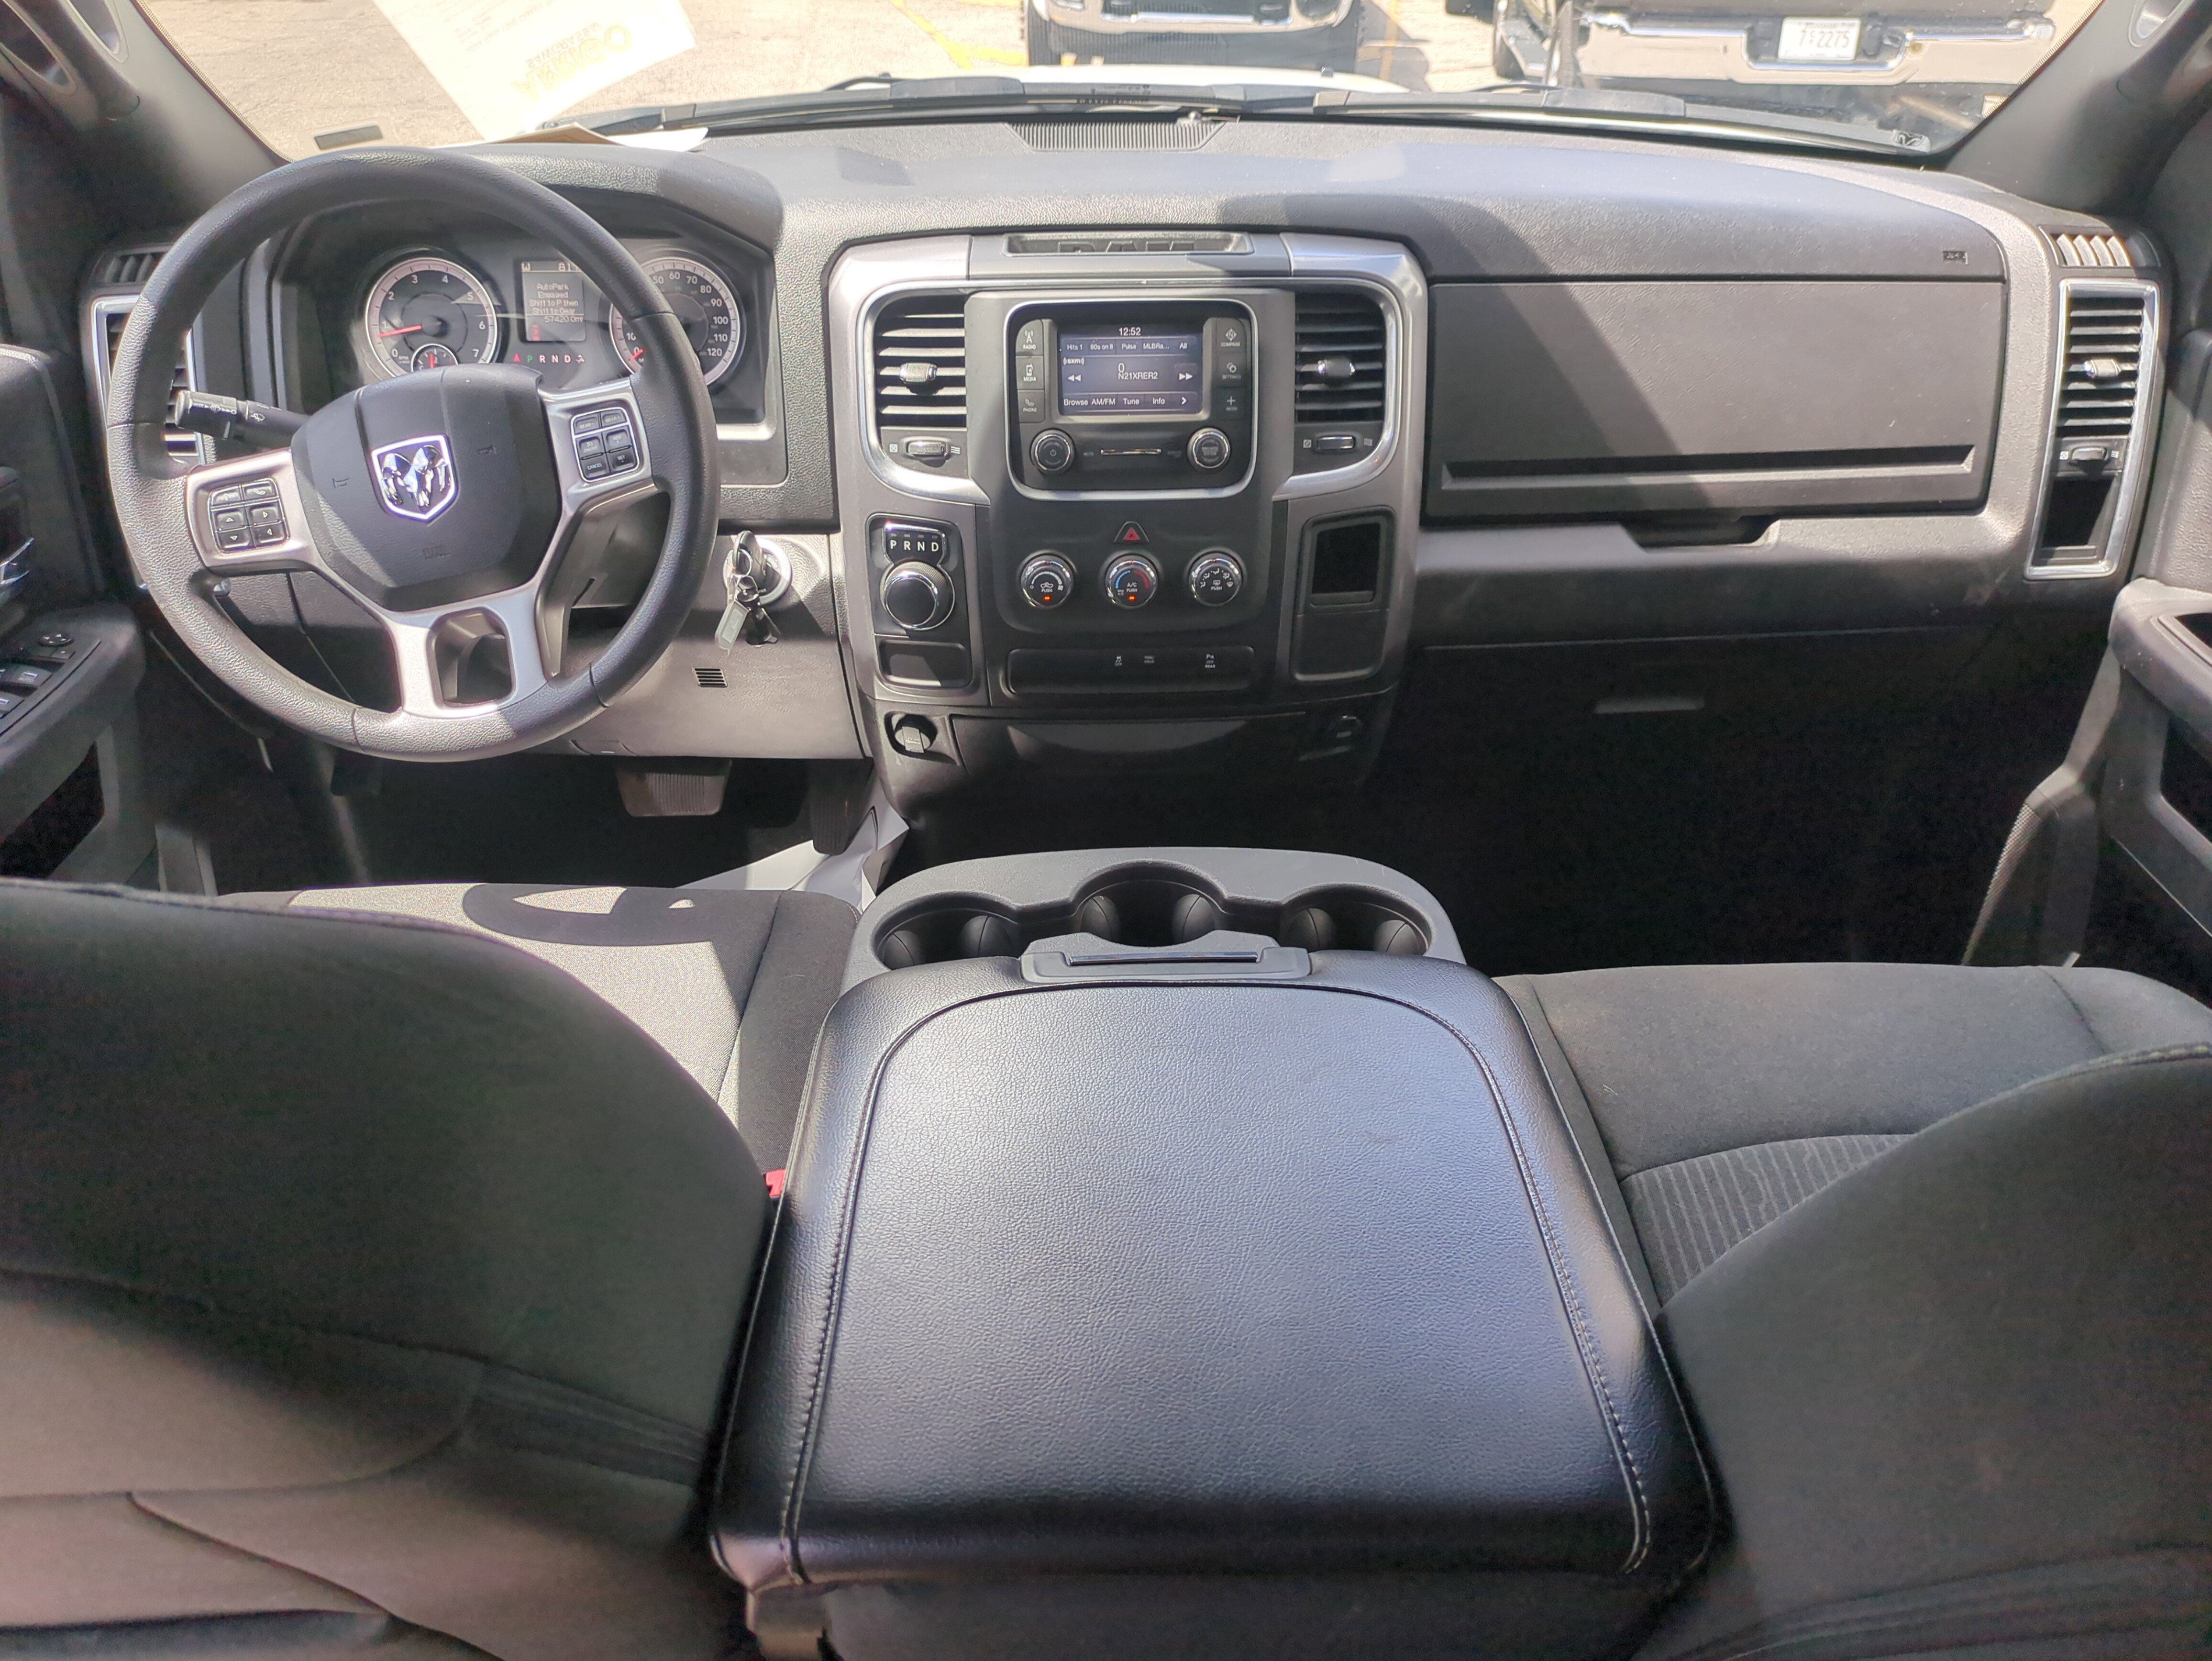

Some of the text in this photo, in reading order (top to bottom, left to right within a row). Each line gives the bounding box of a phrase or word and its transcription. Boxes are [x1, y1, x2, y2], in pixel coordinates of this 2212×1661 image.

[412, 275, 419, 284] 3
[442, 275, 449, 284] 4
[653, 276, 664, 284] 50
[669, 272, 681, 280] 60
[686, 276, 698, 284] 70
[700, 285, 711, 294] 80
[388, 291, 395, 300] 2
[467, 291, 474, 300] 5
[710, 299, 722, 307] 90
[713, 316, 729, 324] 100
[479, 321, 486, 330] 6
[1118, 327, 1141, 336] 12:52
[714, 333, 728, 342] 110
[391, 348, 398, 357] 0
[472, 348, 479, 358] 7
[707, 348, 722, 356] 120
[539, 355, 546, 363] R
[552, 355, 559, 363] N
[564, 355, 572, 363] D
[890, 539, 939, 552] P R N D
